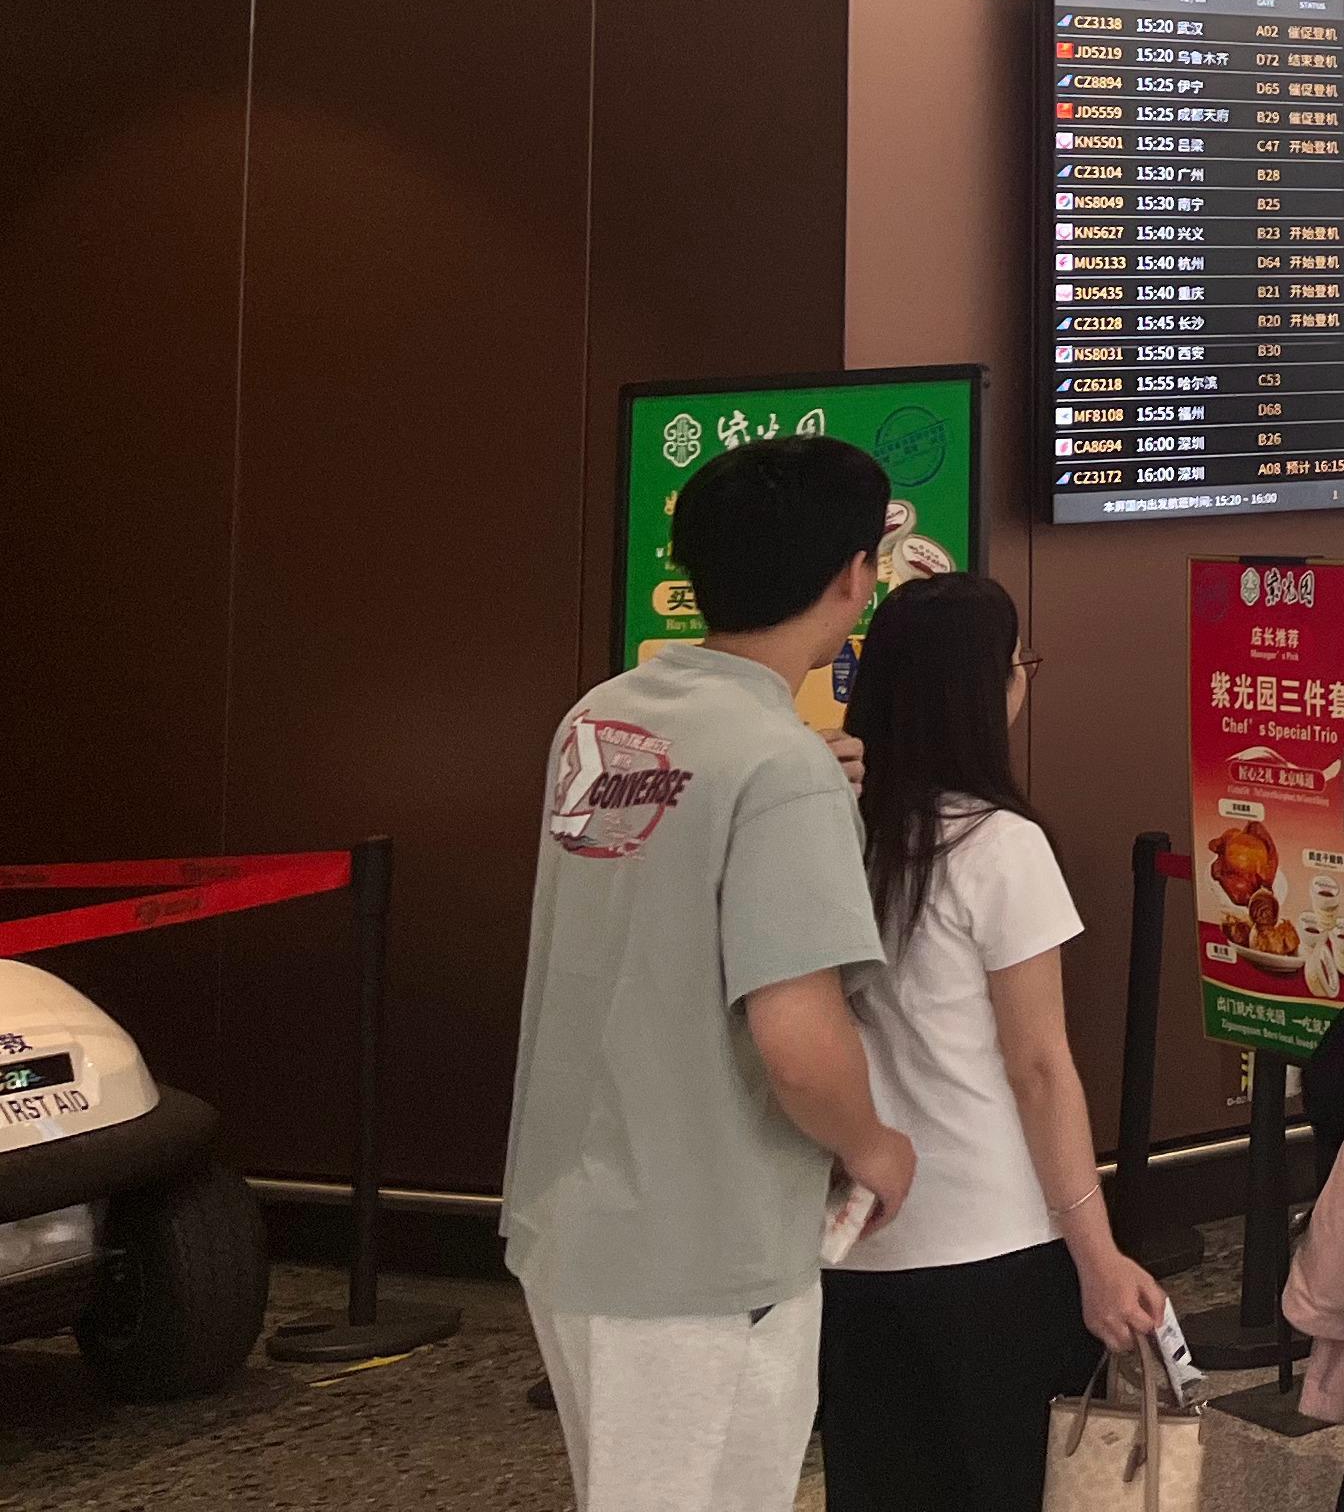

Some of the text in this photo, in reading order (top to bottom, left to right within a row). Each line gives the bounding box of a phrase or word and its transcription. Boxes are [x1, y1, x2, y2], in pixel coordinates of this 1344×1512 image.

[1074, 16, 1203, 35] CZ3138 15:20 武汉
[1074, 46, 1228, 65] JD5219 15:20 乌鲁木齐
[1074, 76, 1203, 94] CZ8894 15:25 伊宁
[1074, 106, 1229, 122] JD5559 15:25 成都天府
[1074, 136, 1122, 148] KN5501
[1137, 137, 1174, 150] 15:25
[1074, 166, 1203, 181] CZ3104 15:30 广州
[1074, 196, 1203, 211] NS8049 15:30 南宁
[1074, 226, 1204, 240] KN5627 15:40 兴义
[1074, 256, 1204, 270] MU5133 15:40 杭州
[1074, 286, 1174, 300] 3U5435 15:40
[1074, 316, 1204, 330] CZ3128 15:45 长沙
[1074, 346, 1204, 360] NS8031 15:50 西安
[1074, 376, 1174, 391] CZ6218 15:55
[1074, 406, 1204, 422] MF8108 15:55 福州
[1137, 437, 1174, 452] 16:00
[1074, 467, 1174, 484] CZ3172 16:00
[1215, 495, 1242, 506] 15:20
[1251, 493, 1278, 504] 16:00
[1250, 626, 1300, 649] 店长推荐
[1268, 721, 1311, 742] Special
[1313, 725, 1338, 744] Trio
[588, 768, 695, 809] CONVERSE
[0, 1089, 90, 1125] IRST AID
